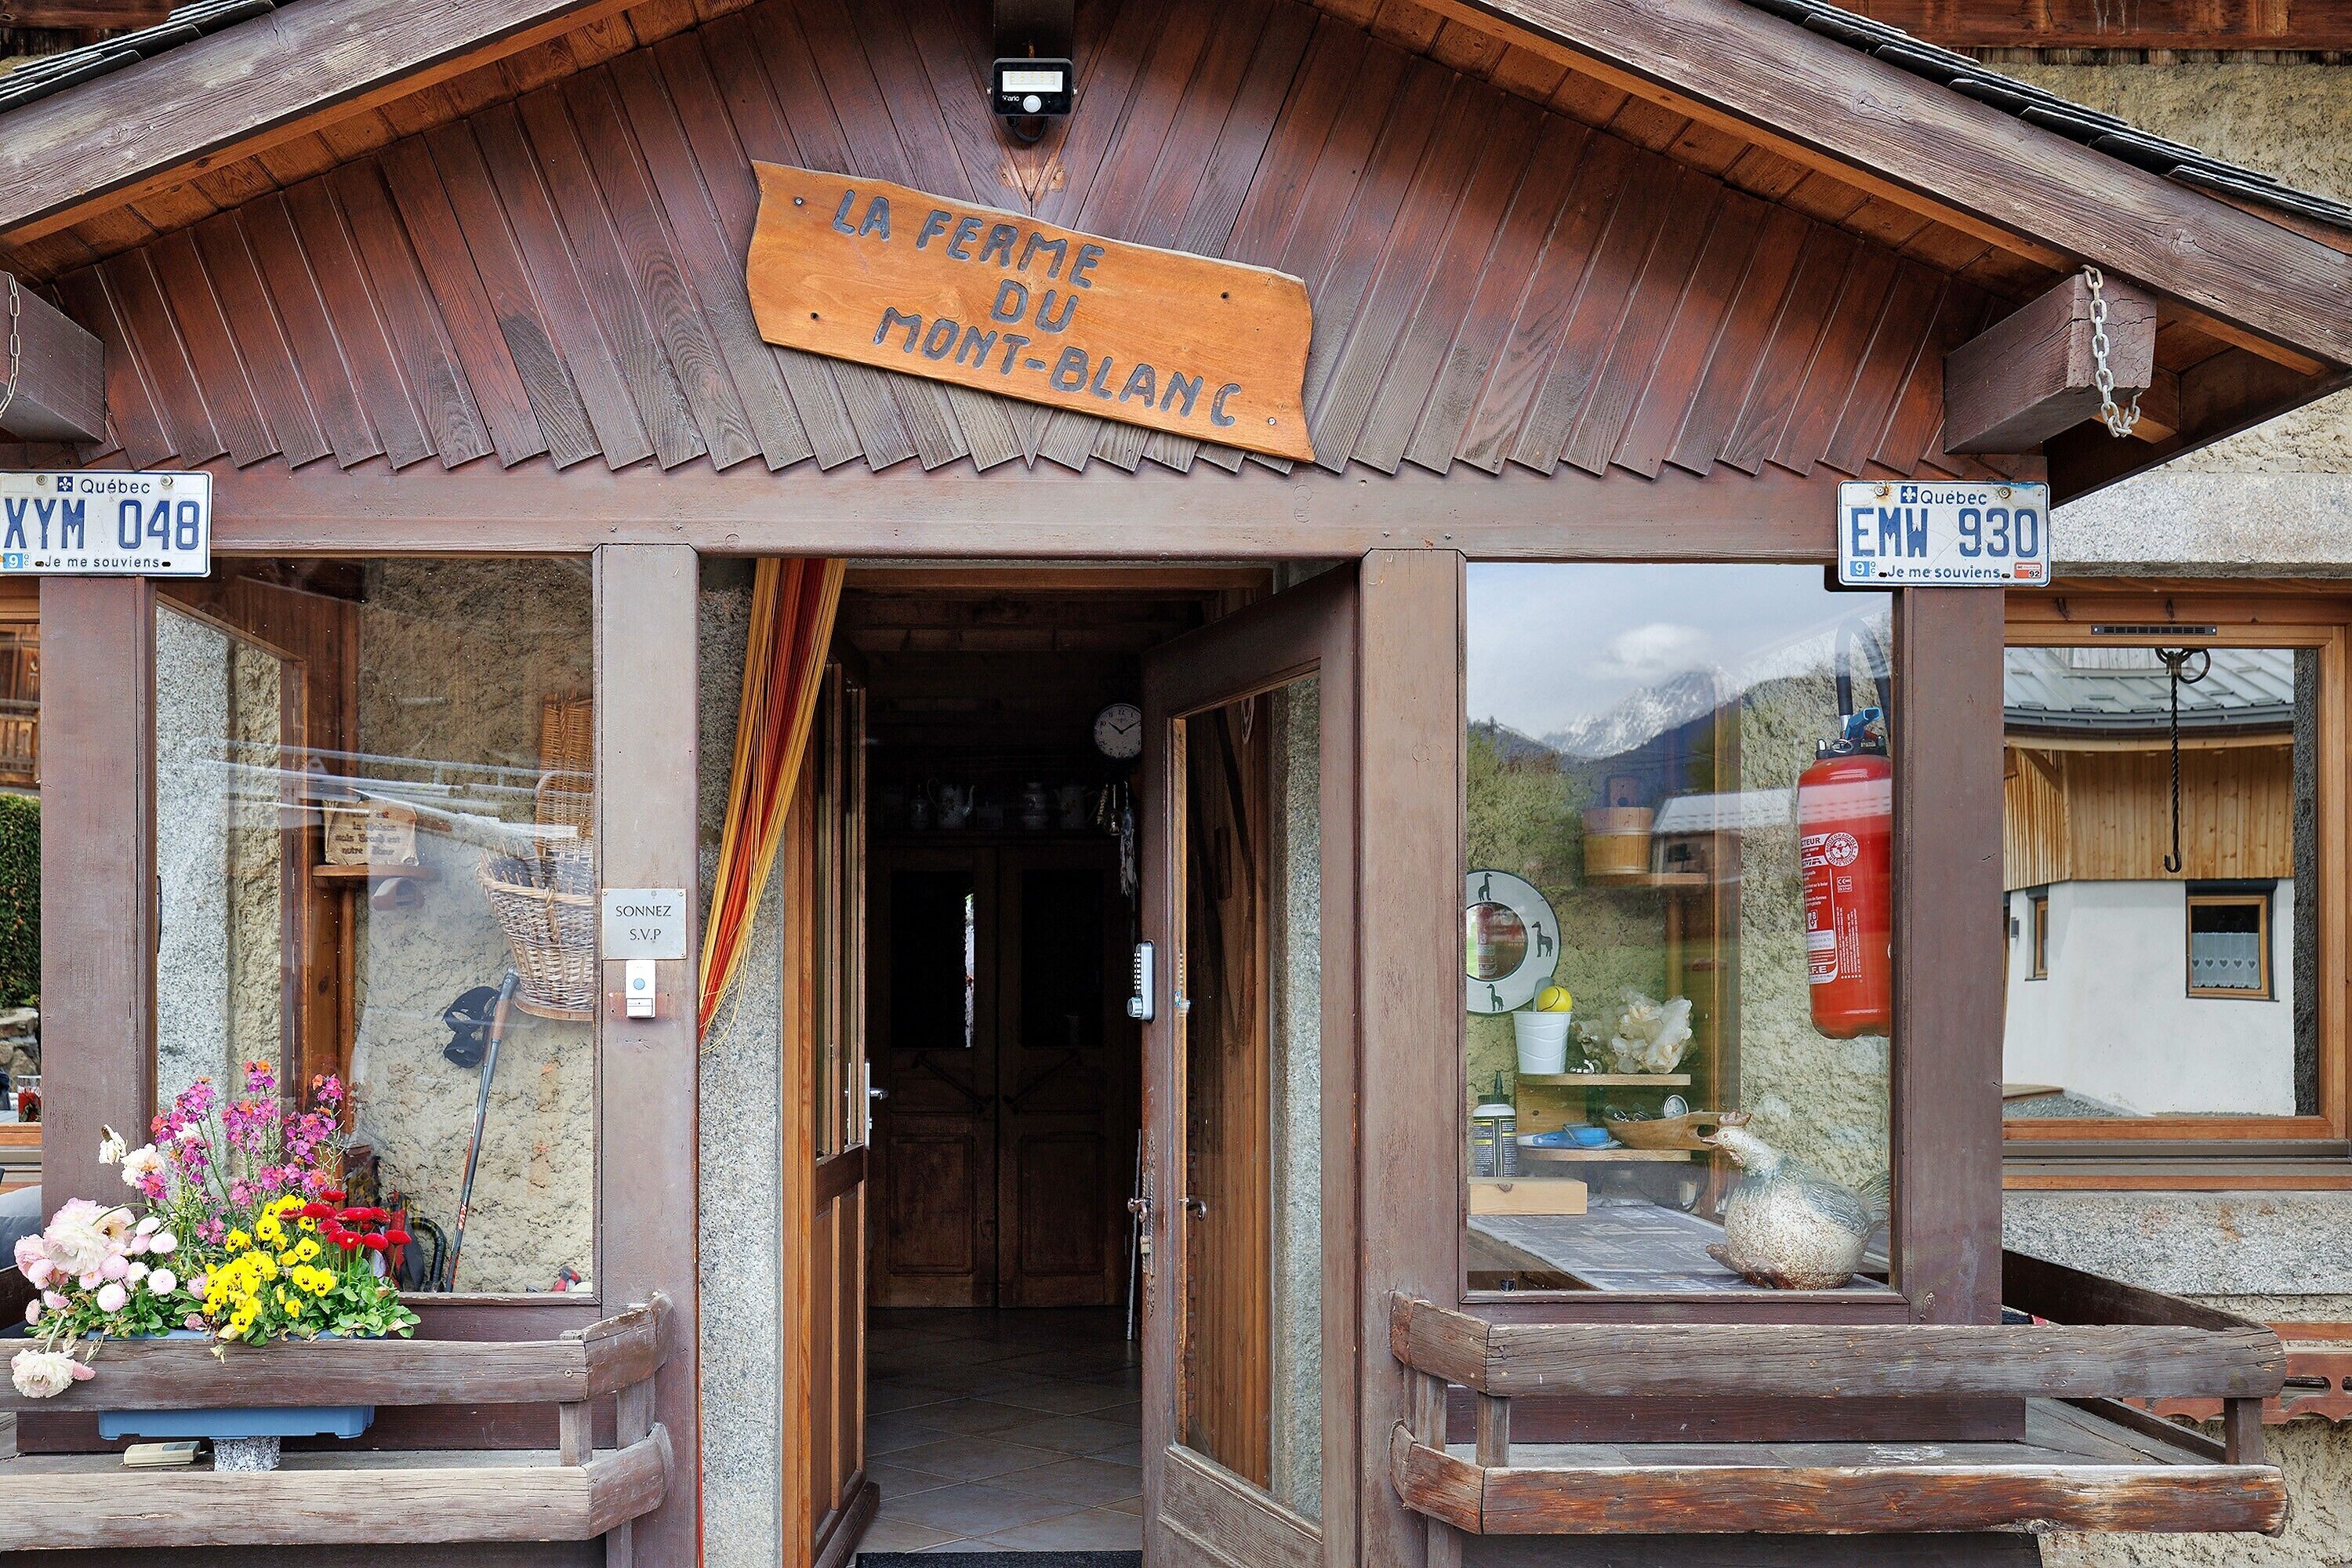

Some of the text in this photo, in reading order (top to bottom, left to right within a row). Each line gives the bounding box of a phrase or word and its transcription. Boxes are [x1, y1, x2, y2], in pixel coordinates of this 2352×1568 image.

[832, 189, 1105, 289] LA FERME
[991, 279, 1079, 334] DU
[873, 307, 1242, 427] MONT-BLANC
[81, 478, 151, 494] Québec
[1921, 490, 1987, 505] Québec
[4, 498, 200, 550] XYM 048
[1851, 507, 2038, 557] EMW 930
[45, 555, 159, 568] Je me souviens
[1888, 565, 2001, 578] Je me souviens
[615, 905, 672, 917] SONNEZ
[630, 928, 662, 941] S.V.P
